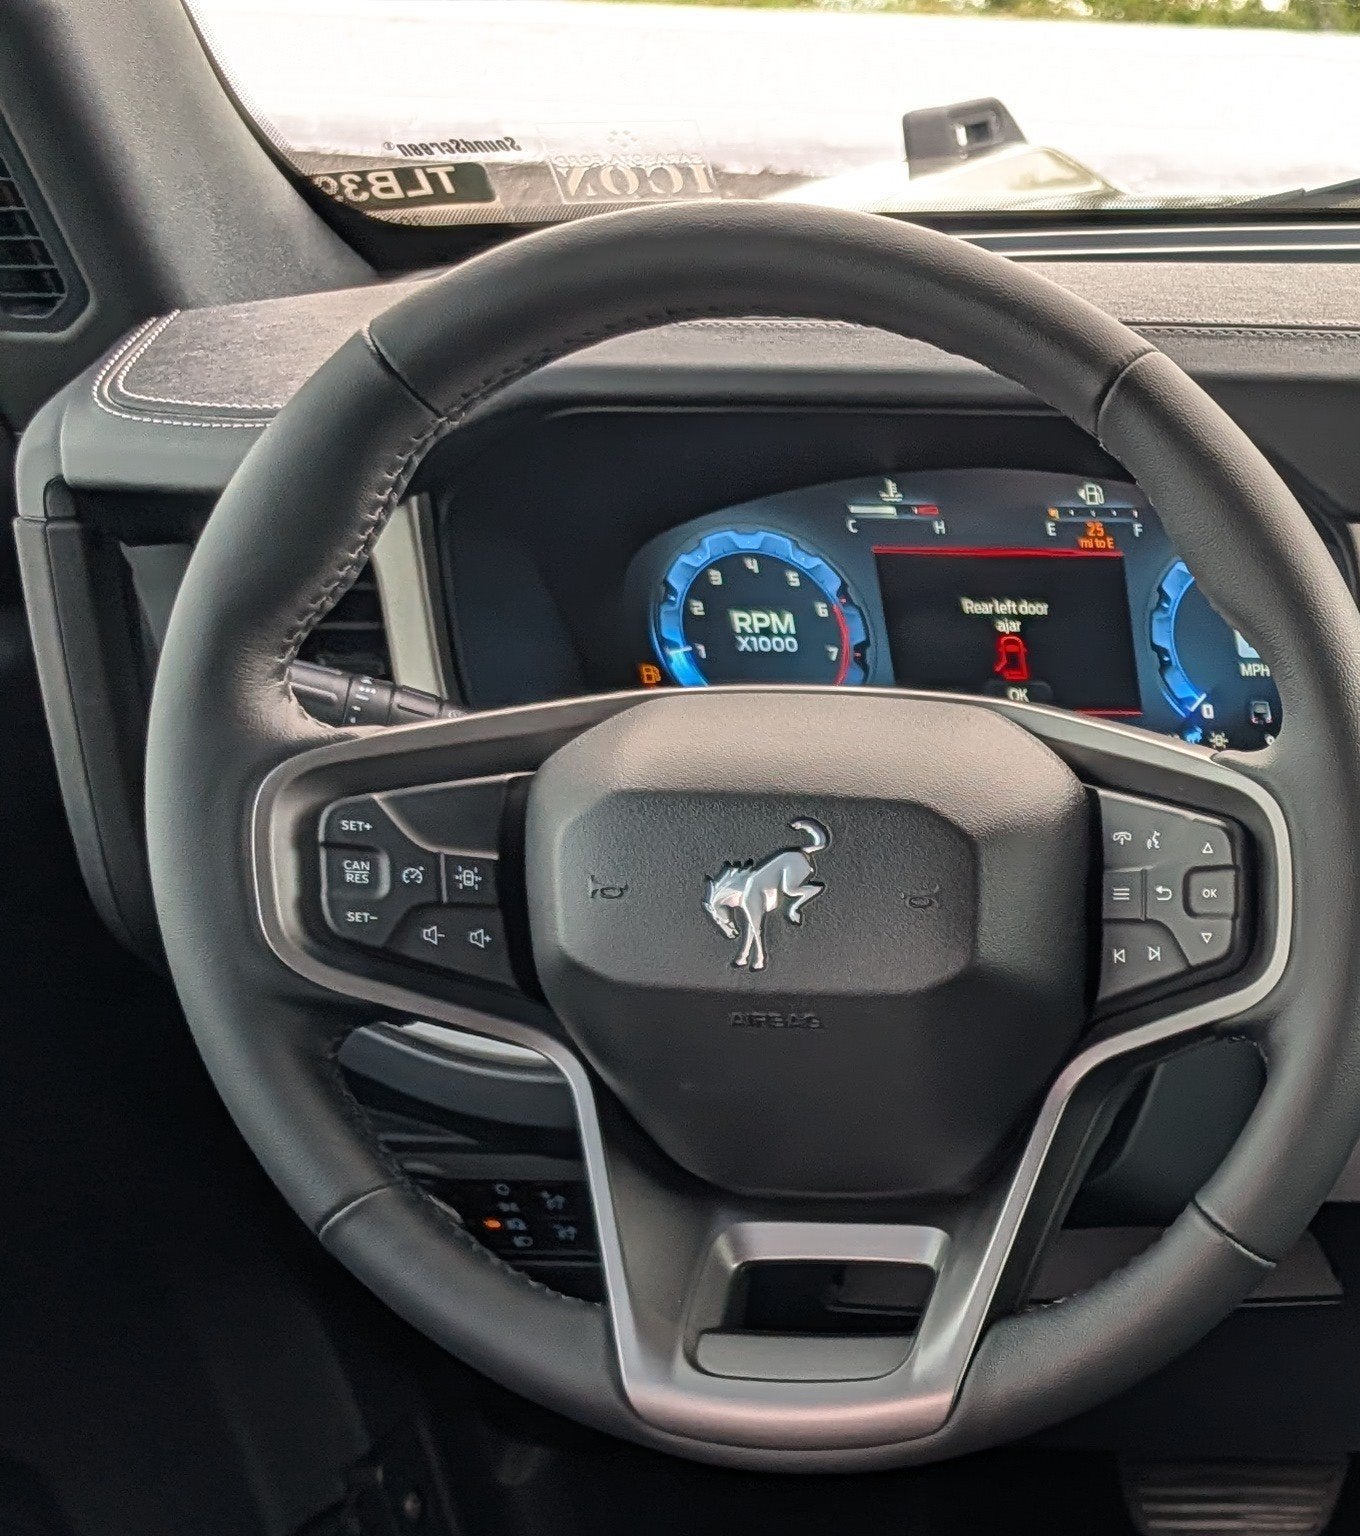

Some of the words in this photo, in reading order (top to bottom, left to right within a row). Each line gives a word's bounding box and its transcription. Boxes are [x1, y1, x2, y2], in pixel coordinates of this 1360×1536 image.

[847, 519, 859, 534] C
[933, 519, 946, 535] H
[1045, 522, 1057, 537] E
[1086, 522, 1105, 537] 25
[1133, 522, 1143, 537] F
[743, 557, 760, 574] 4
[708, 568, 723, 586] 3
[785, 570, 800, 587] 5
[689, 600, 705, 616] 2
[815, 602, 829, 618] 6
[962, 597, 993, 616] Rear
[994, 598, 1017, 616] left
[1019, 598, 1049, 616] door
[731, 610, 797, 635] RPM
[995, 619, 1021, 634] ajar
[695, 643, 707, 659] 1
[736, 635, 799, 652] X1000
[826, 645, 839, 661] 7
[1239, 663, 1271, 677] MPH
[1007, 686, 1028, 702] OK
[341, 820, 373, 832] SET+
[343, 860, 370, 871] CAN
[345, 873, 370, 884] RES
[1202, 888, 1217, 898] OK
